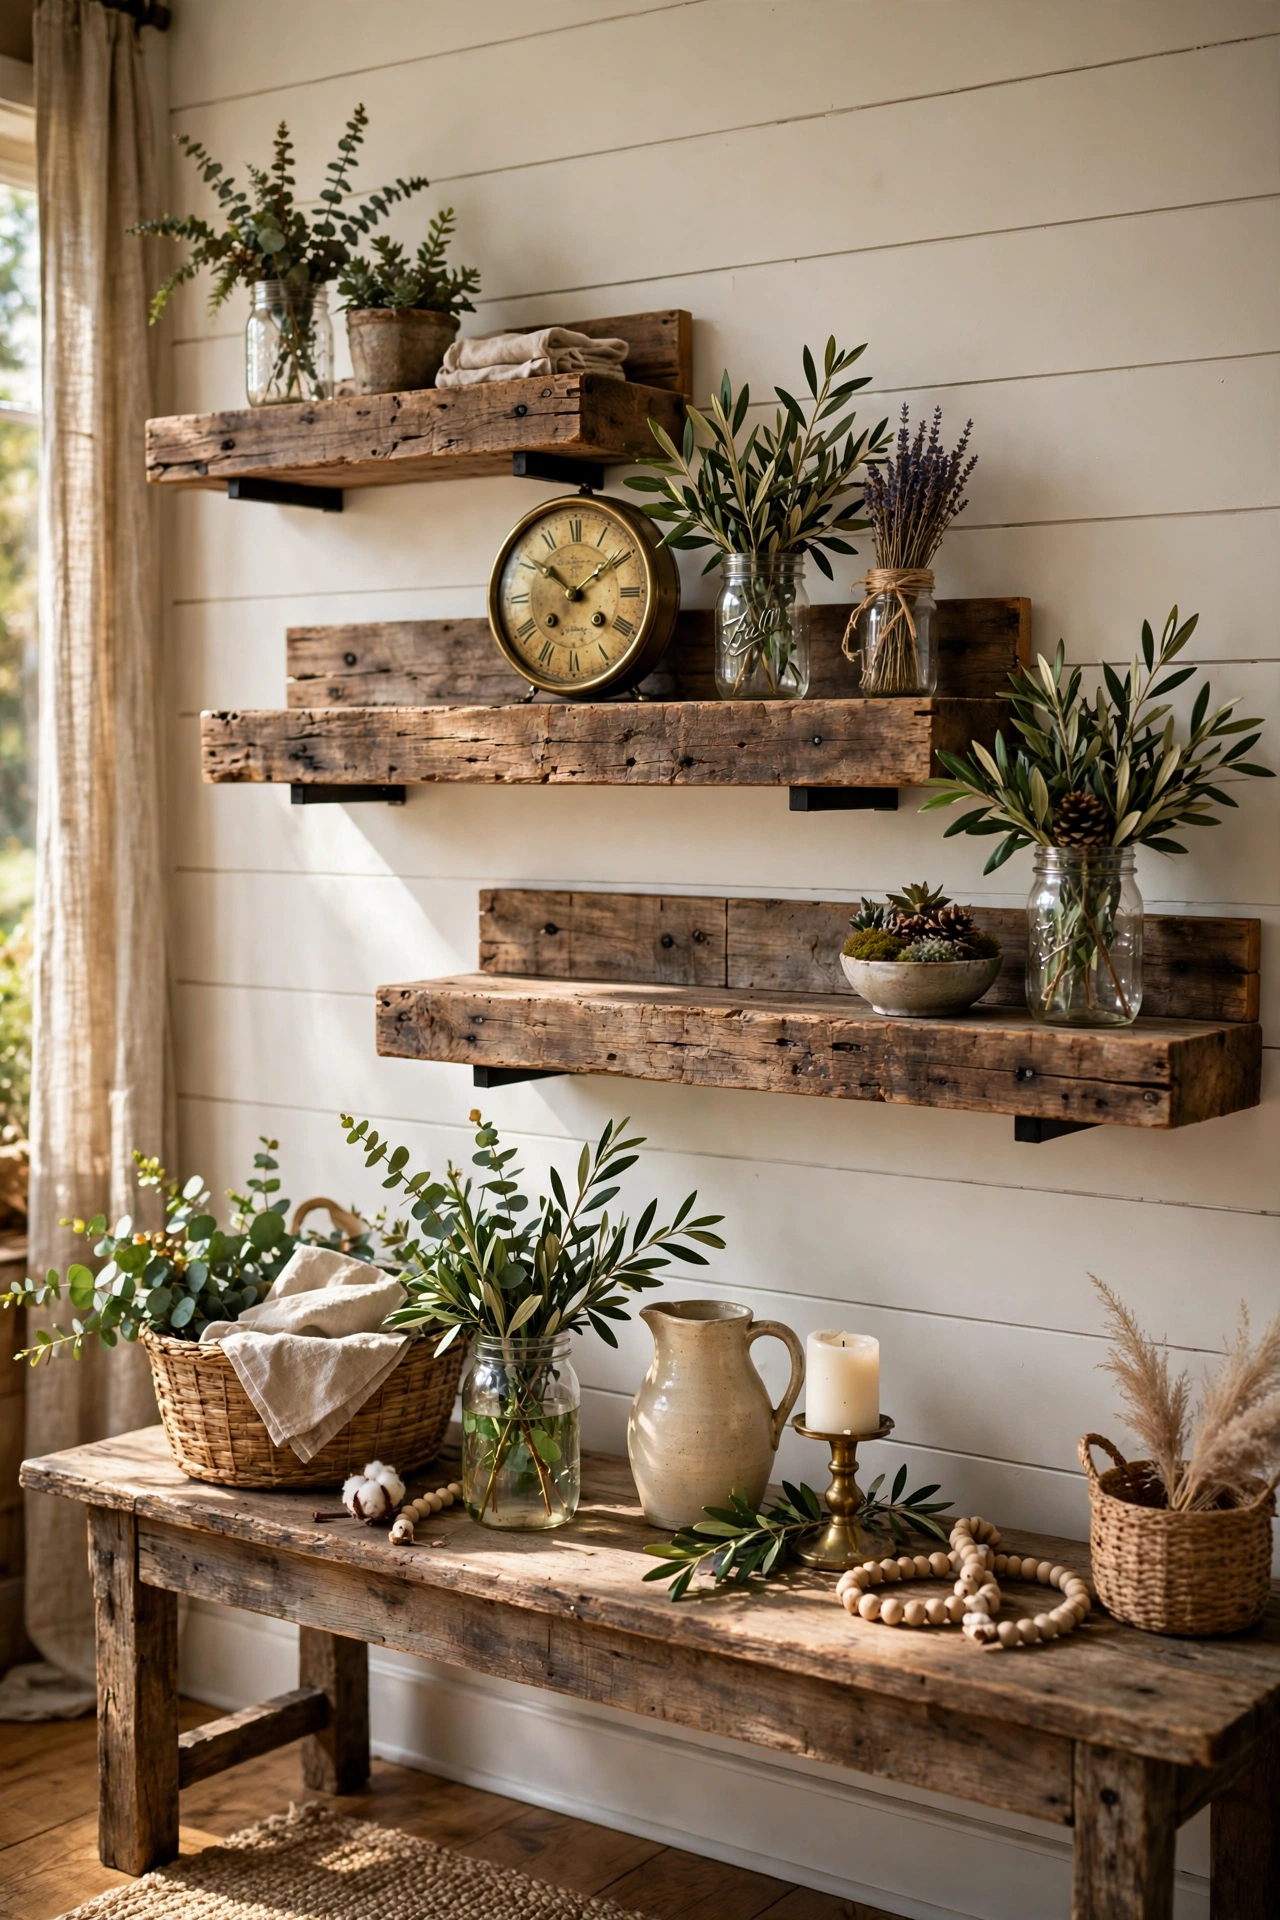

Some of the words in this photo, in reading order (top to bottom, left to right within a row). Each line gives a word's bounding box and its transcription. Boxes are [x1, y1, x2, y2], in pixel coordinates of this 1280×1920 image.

[620, 587, 640, 598] III
[612, 615, 634, 637] IIII
[722, 606, 782, 658] Ball
